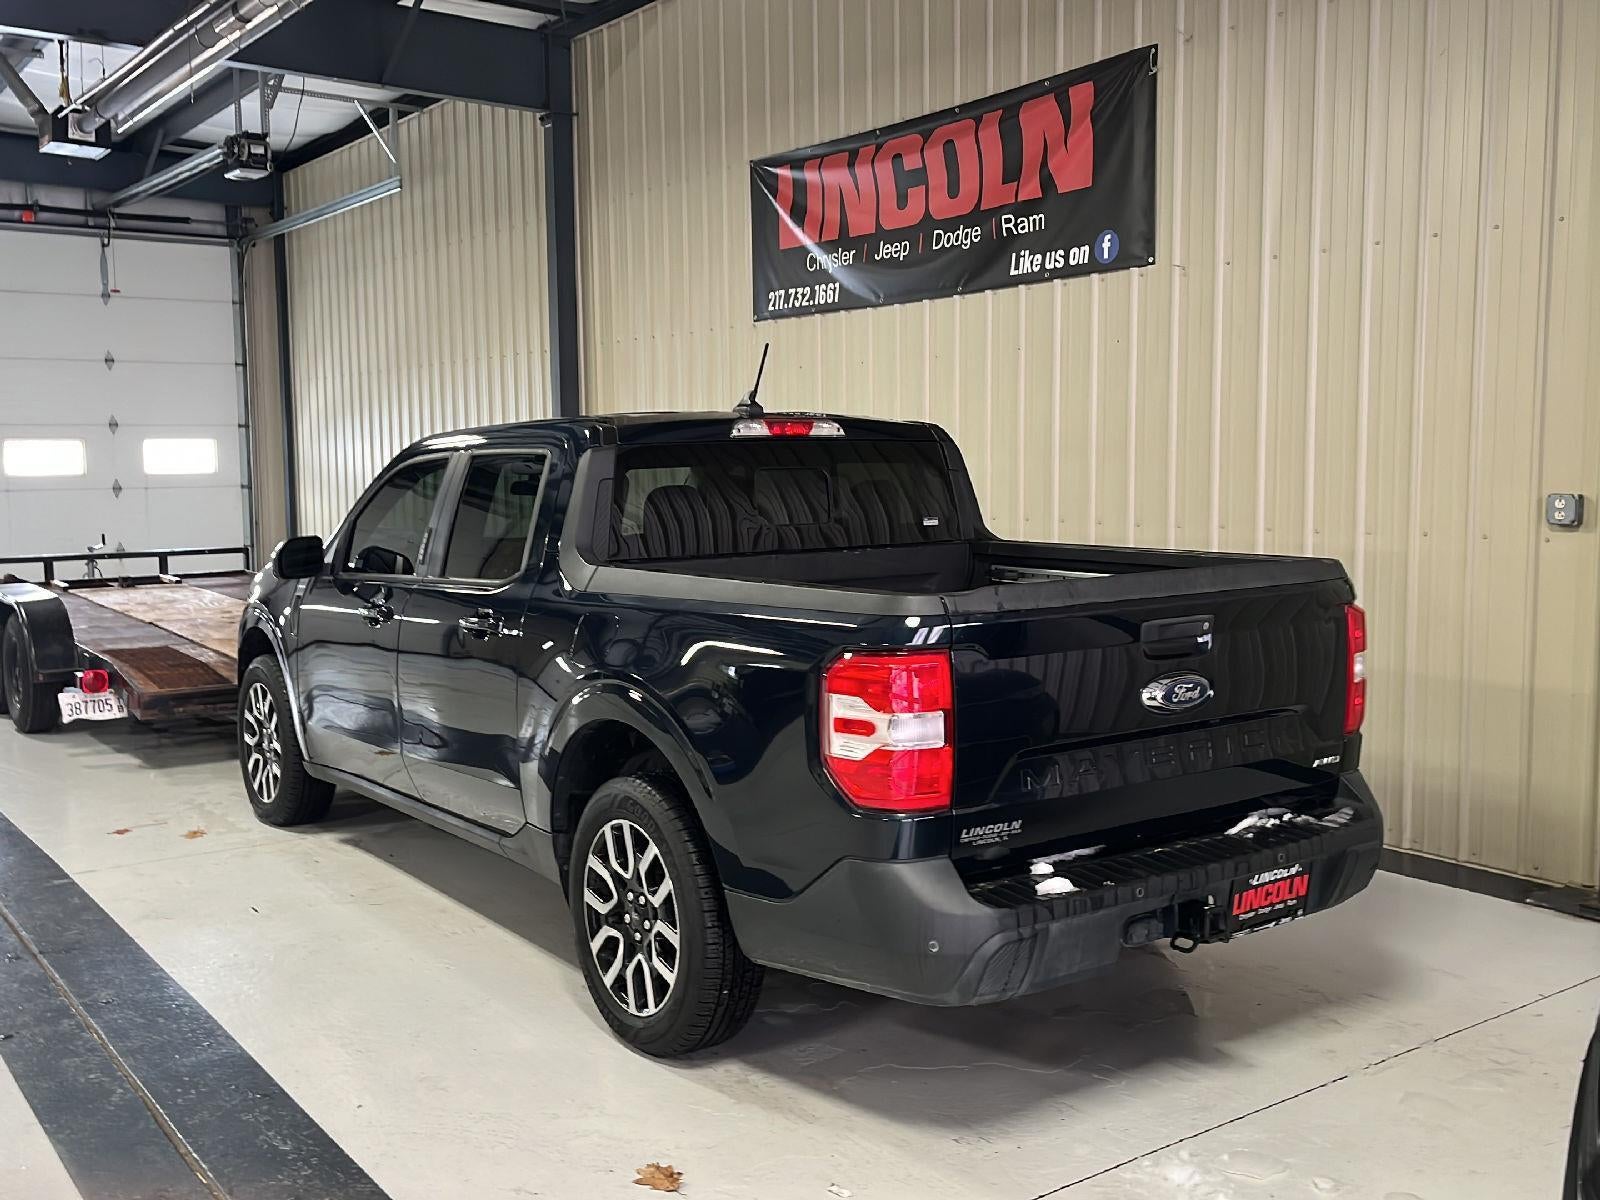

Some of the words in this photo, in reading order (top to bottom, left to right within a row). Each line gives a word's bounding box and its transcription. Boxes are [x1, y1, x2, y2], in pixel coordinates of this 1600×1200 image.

[776, 81, 1096, 250] LINCOLN
[806, 248, 855, 273] Chrysler
[874, 240, 910, 261] Jeep
[932, 225, 982, 250] Dodge
[1001, 213, 1046, 237] Ram
[1009, 250, 1041, 276] Like
[1044, 248, 1065, 269] us
[1068, 244, 1090, 266] on
[767, 282, 840, 311] 217.732.1661
[65, 698, 114, 718] 387705
[1171, 683, 1201, 703] Ford
[960, 819, 1022, 838] LINCOLN
[1232, 873, 1309, 916] LINCOLN
